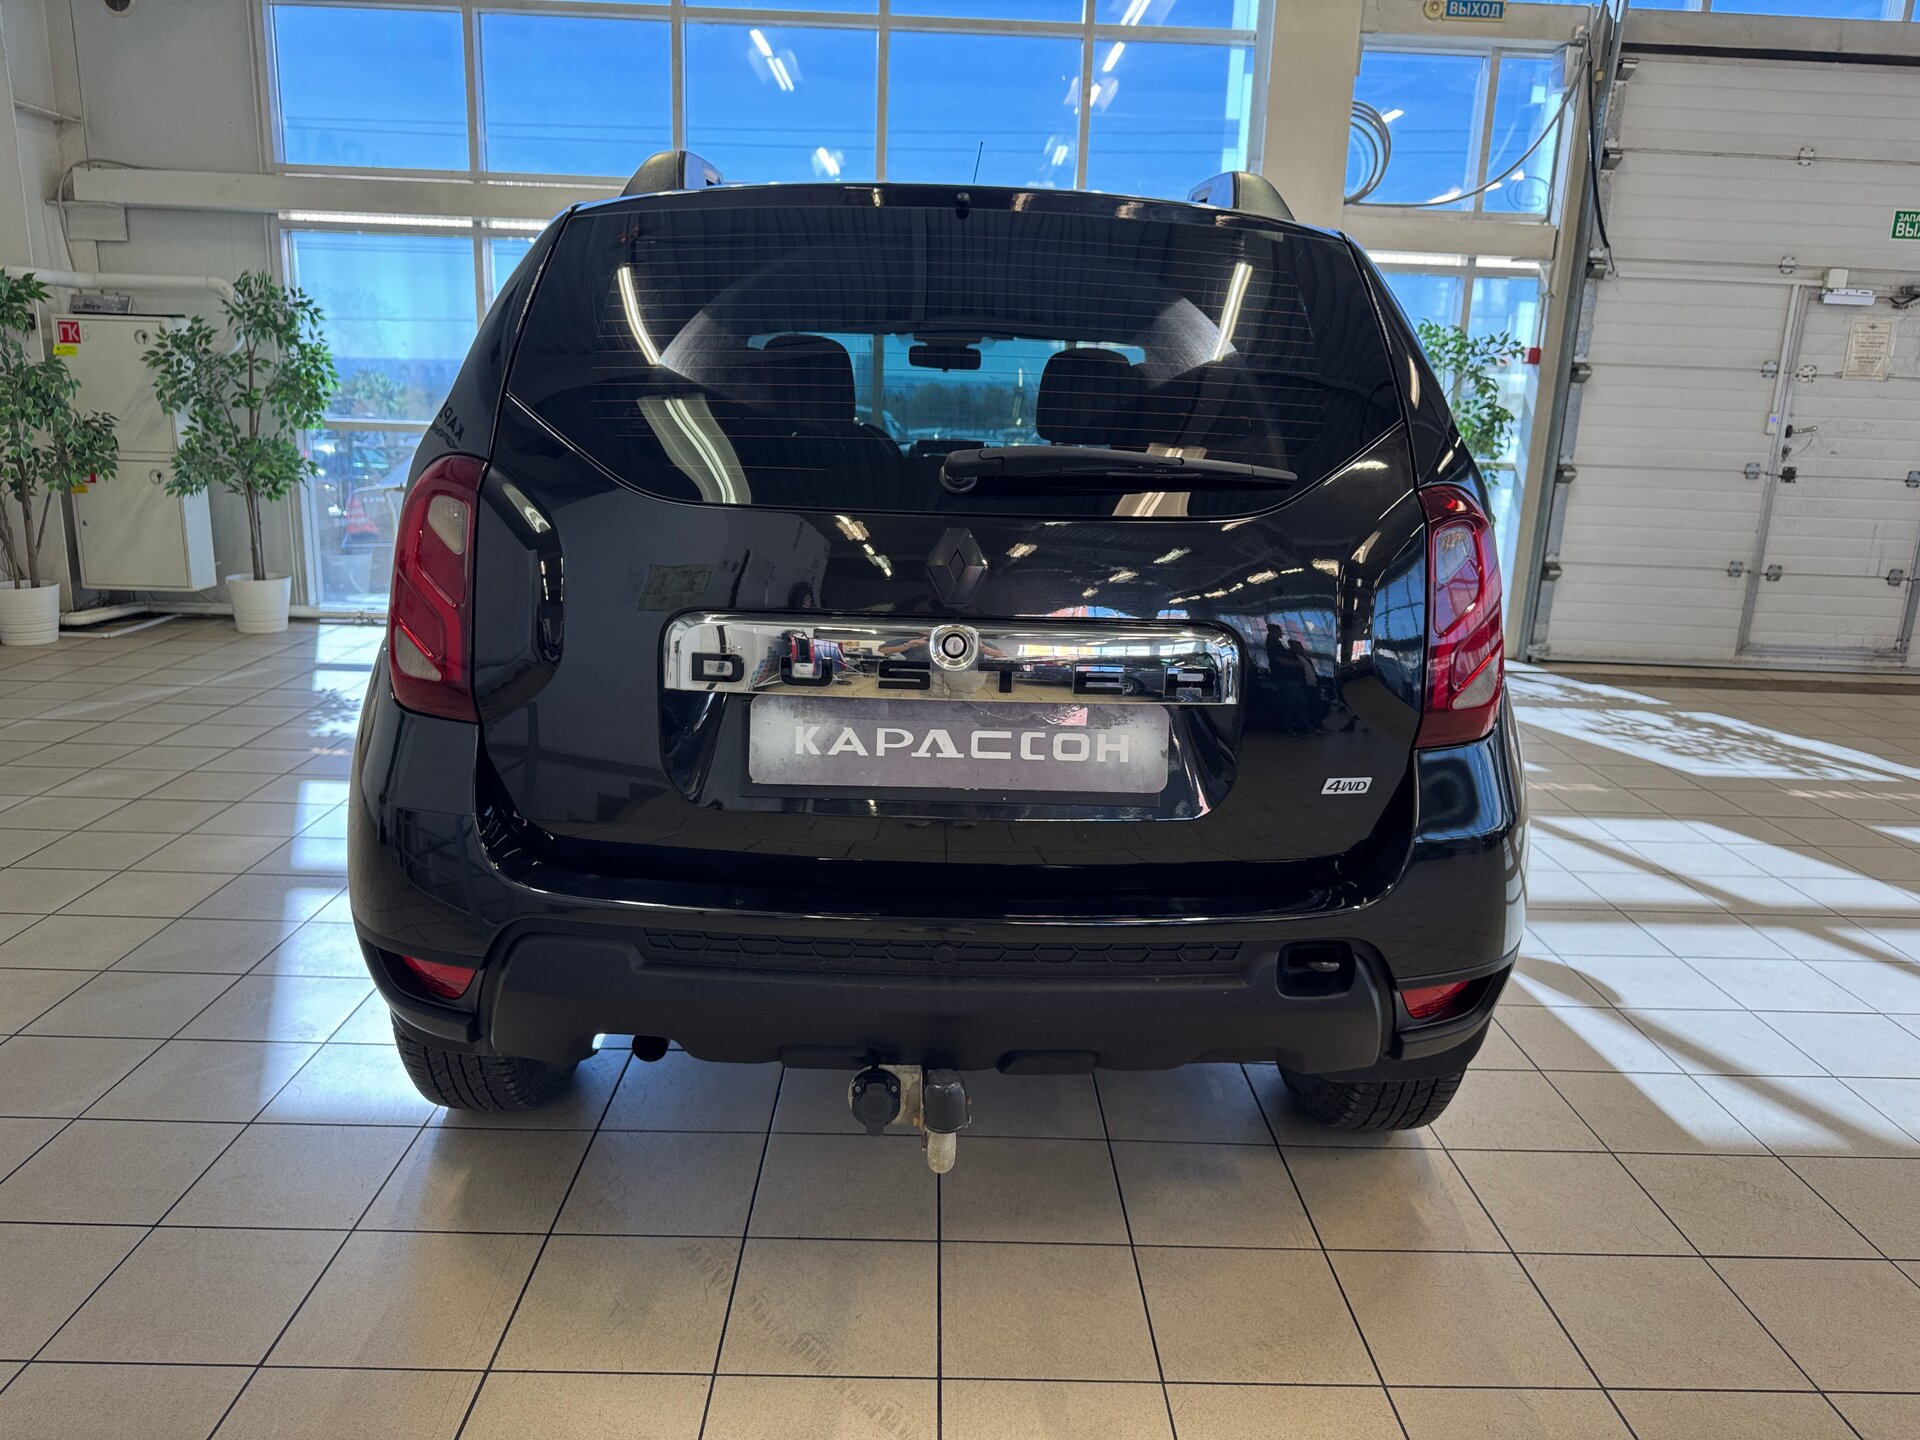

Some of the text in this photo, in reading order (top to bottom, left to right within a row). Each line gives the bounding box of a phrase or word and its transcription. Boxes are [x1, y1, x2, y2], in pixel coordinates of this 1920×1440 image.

[1449, 1, 1501, 18] ВЫХОД
[58, 323, 80, 341] ПК
[691, 652, 1216, 698] DUSTER
[1326, 779, 1368, 793] 4WD
